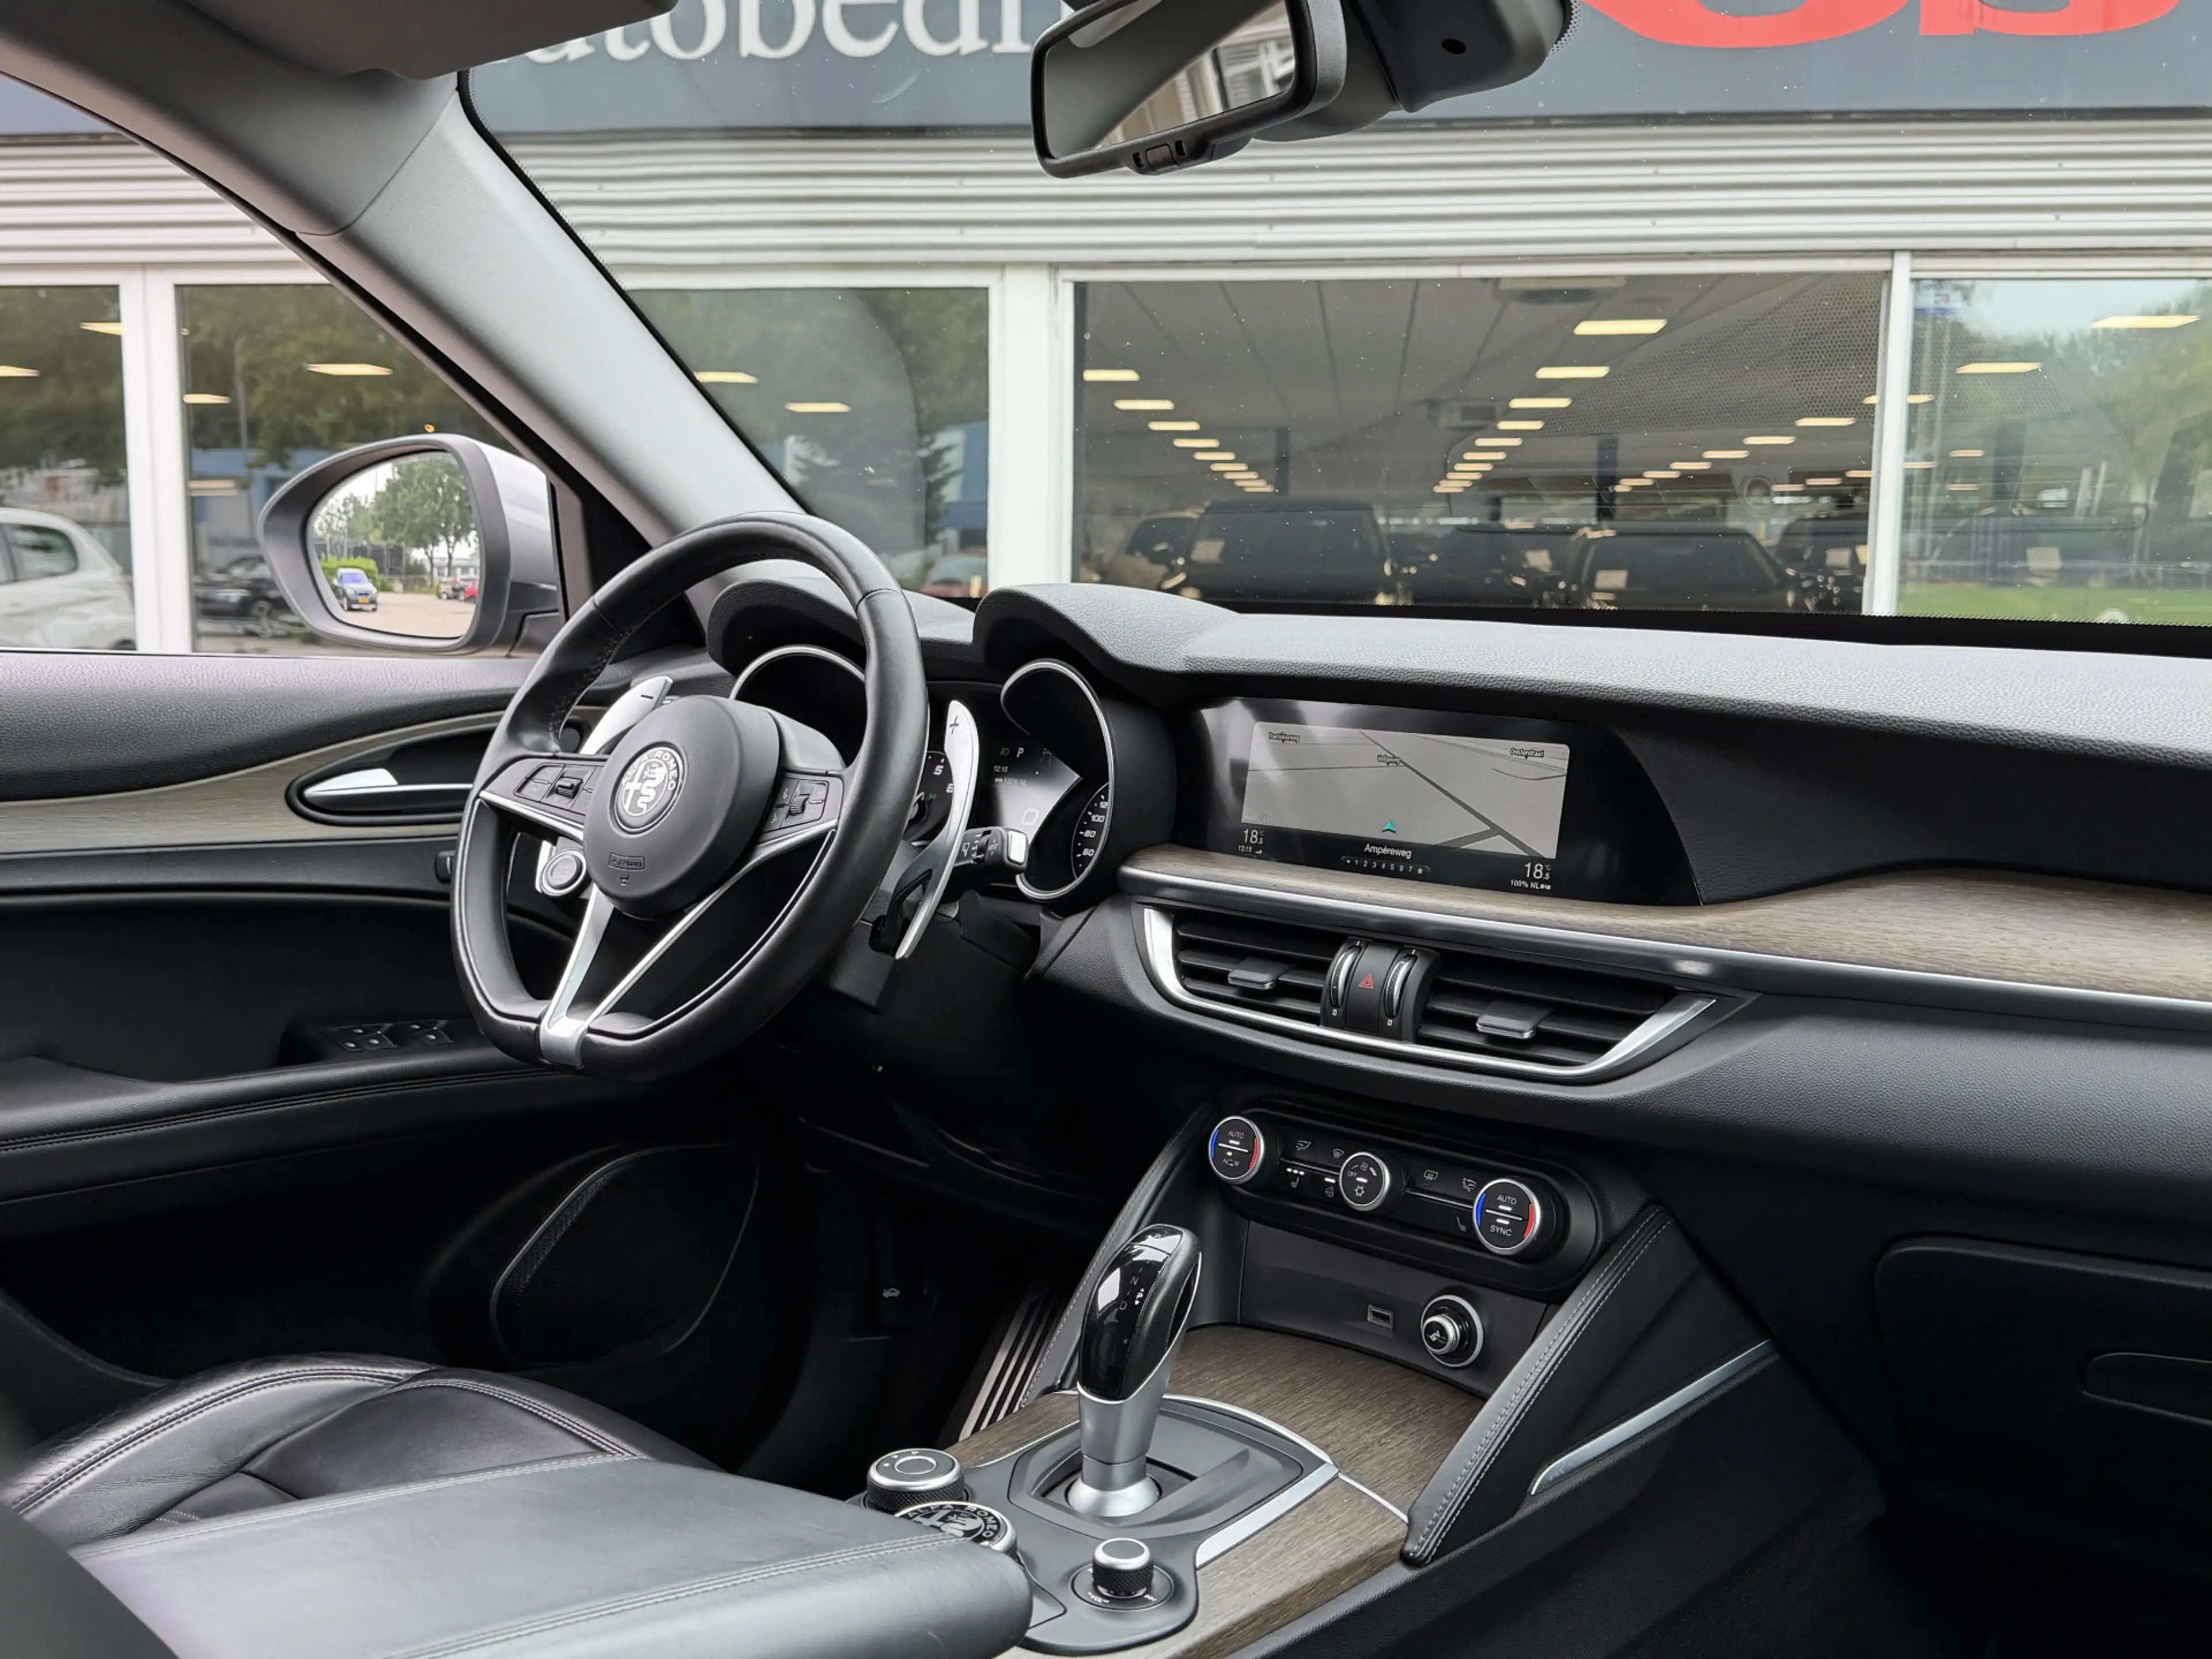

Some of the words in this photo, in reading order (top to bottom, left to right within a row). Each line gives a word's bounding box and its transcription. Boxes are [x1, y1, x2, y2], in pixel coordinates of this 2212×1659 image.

[654, 750, 678, 791] ROMEO
[933, 765, 945, 776] 5
[1091, 815, 1105, 823] 100
[1084, 830, 1097, 838] 80
[1082, 848, 1094, 857] 60
[1228, 1130, 1245, 1139] AUTO
[1497, 1194, 1517, 1205] AUTO
[1490, 1224, 1512, 1237] SYNC
[1130, 1275, 1139, 1286] N
[1119, 1300, 1128, 1310] D
[907, 1504, 955, 1518] ALFA
[964, 1505, 998, 1537] ROMEO
